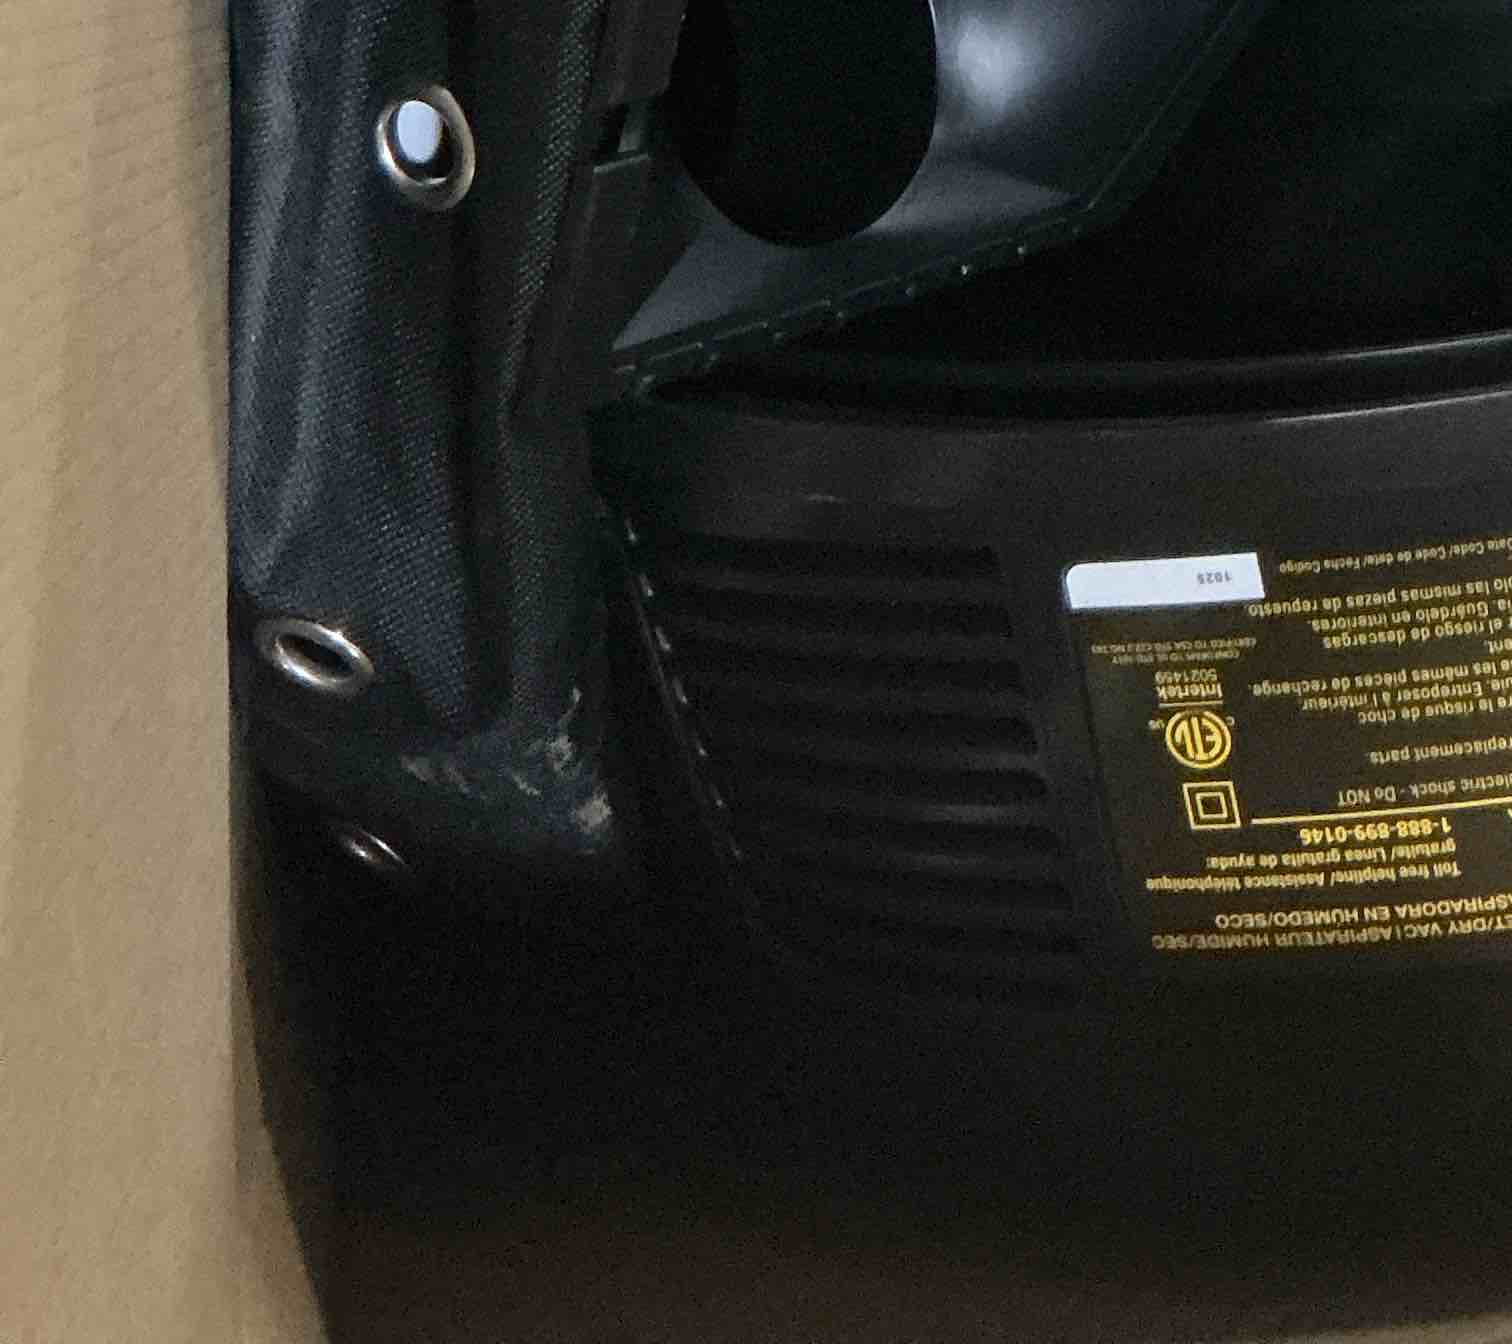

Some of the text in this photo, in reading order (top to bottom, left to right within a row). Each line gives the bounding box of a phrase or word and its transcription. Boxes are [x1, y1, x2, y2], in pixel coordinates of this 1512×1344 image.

[1400, 584, 1462, 602] mismas
[1465, 580, 1490, 596] las
[1322, 596, 1342, 613] de
[1346, 588, 1397, 608] piezas
[1391, 609, 1411, 624] en
[1415, 601, 1489, 624] Guárdelo
[1410, 626, 1431, 642] de
[1434, 616, 1485, 638] riesgo
[1488, 617, 1503, 635] el
[1323, 628, 1407, 649] descargas
[1472, 661, 1497, 676] les
[1156, 683, 1223, 701] Intertek
[1248, 679, 1328, 697] rechange.
[1331, 676, 1351, 693] de
[1397, 681, 1483, 702] Entreposer
[1401, 705, 1421, 723] de
[1425, 700, 1474, 717] risque
[1478, 698, 1494, 713] le
[1357, 708, 1397, 725] choc
[1338, 789, 1371, 807] NOT
[1373, 785, 1397, 803] Do
[1409, 780, 1456, 799] shock
[1299, 817, 1451, 845] 1-888-899-0146
[1258, 854, 1279, 869] de
[1281, 847, 1341, 867] gratuita
[1330, 866, 1397, 886] helpline/
[1398, 864, 1430, 879] free
[1433, 861, 1462, 877] Toll
[1243, 871, 1325, 888] Assistance
[1363, 905, 1391, 921] EN
[1152, 926, 1270, 950] HUMIDE/SEC
[1274, 925, 1393, 946] ASPIRATEUR
[1403, 921, 1443, 938] VAC
